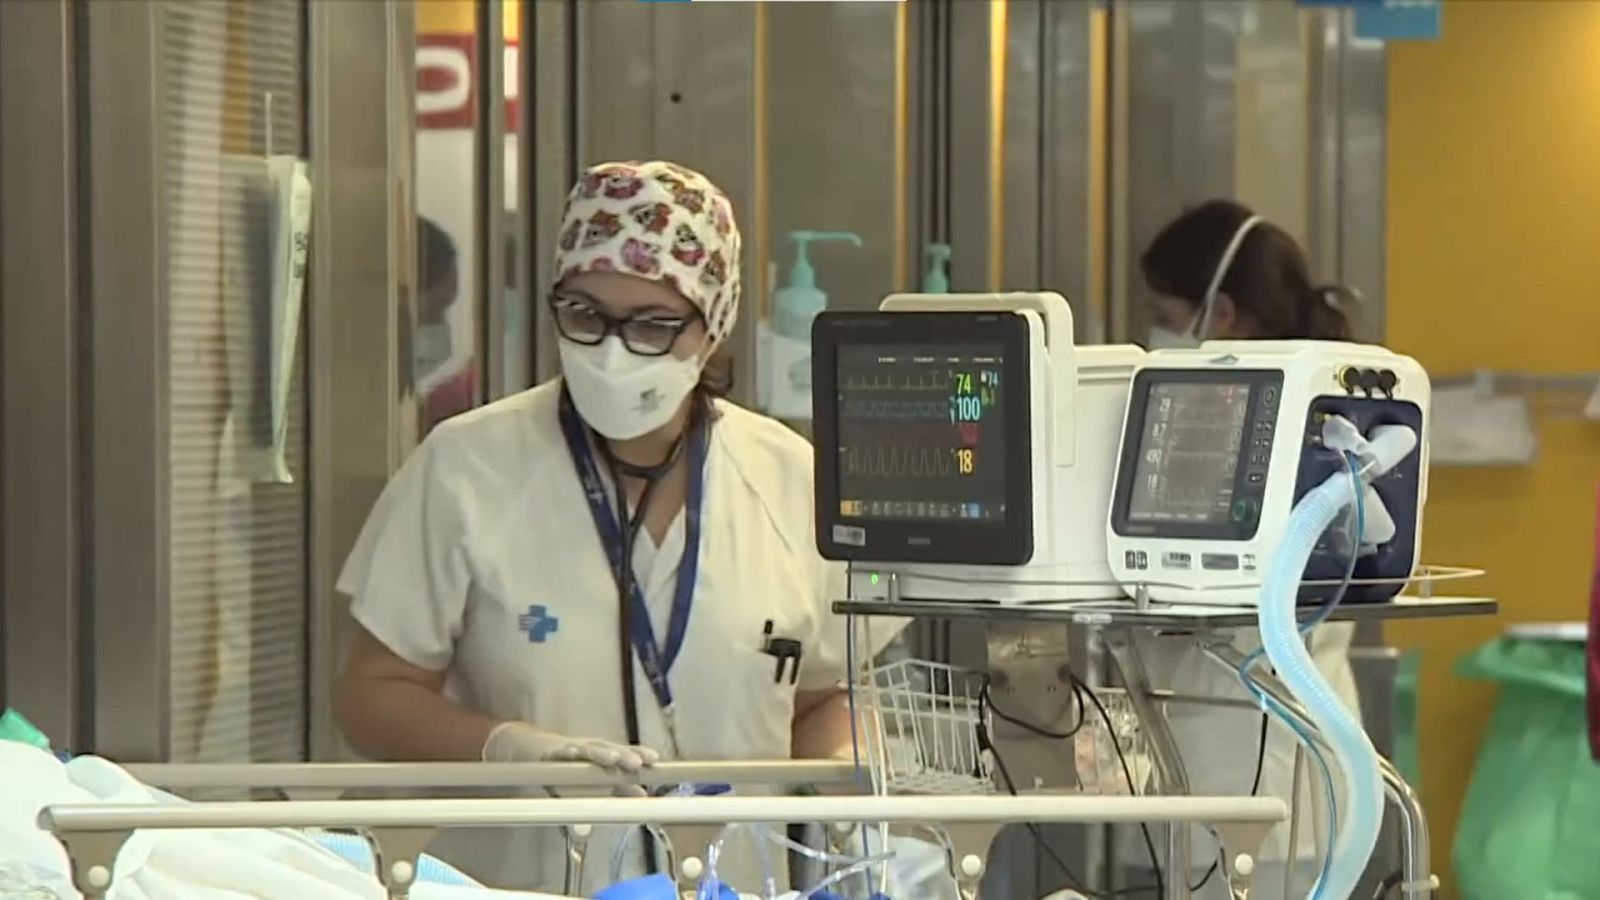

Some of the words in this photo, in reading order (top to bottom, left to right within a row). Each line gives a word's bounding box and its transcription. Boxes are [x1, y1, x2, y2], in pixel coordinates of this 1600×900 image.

[956, 373, 971, 394] 74
[957, 396, 980, 421] 100
[958, 449, 972, 475] 18
